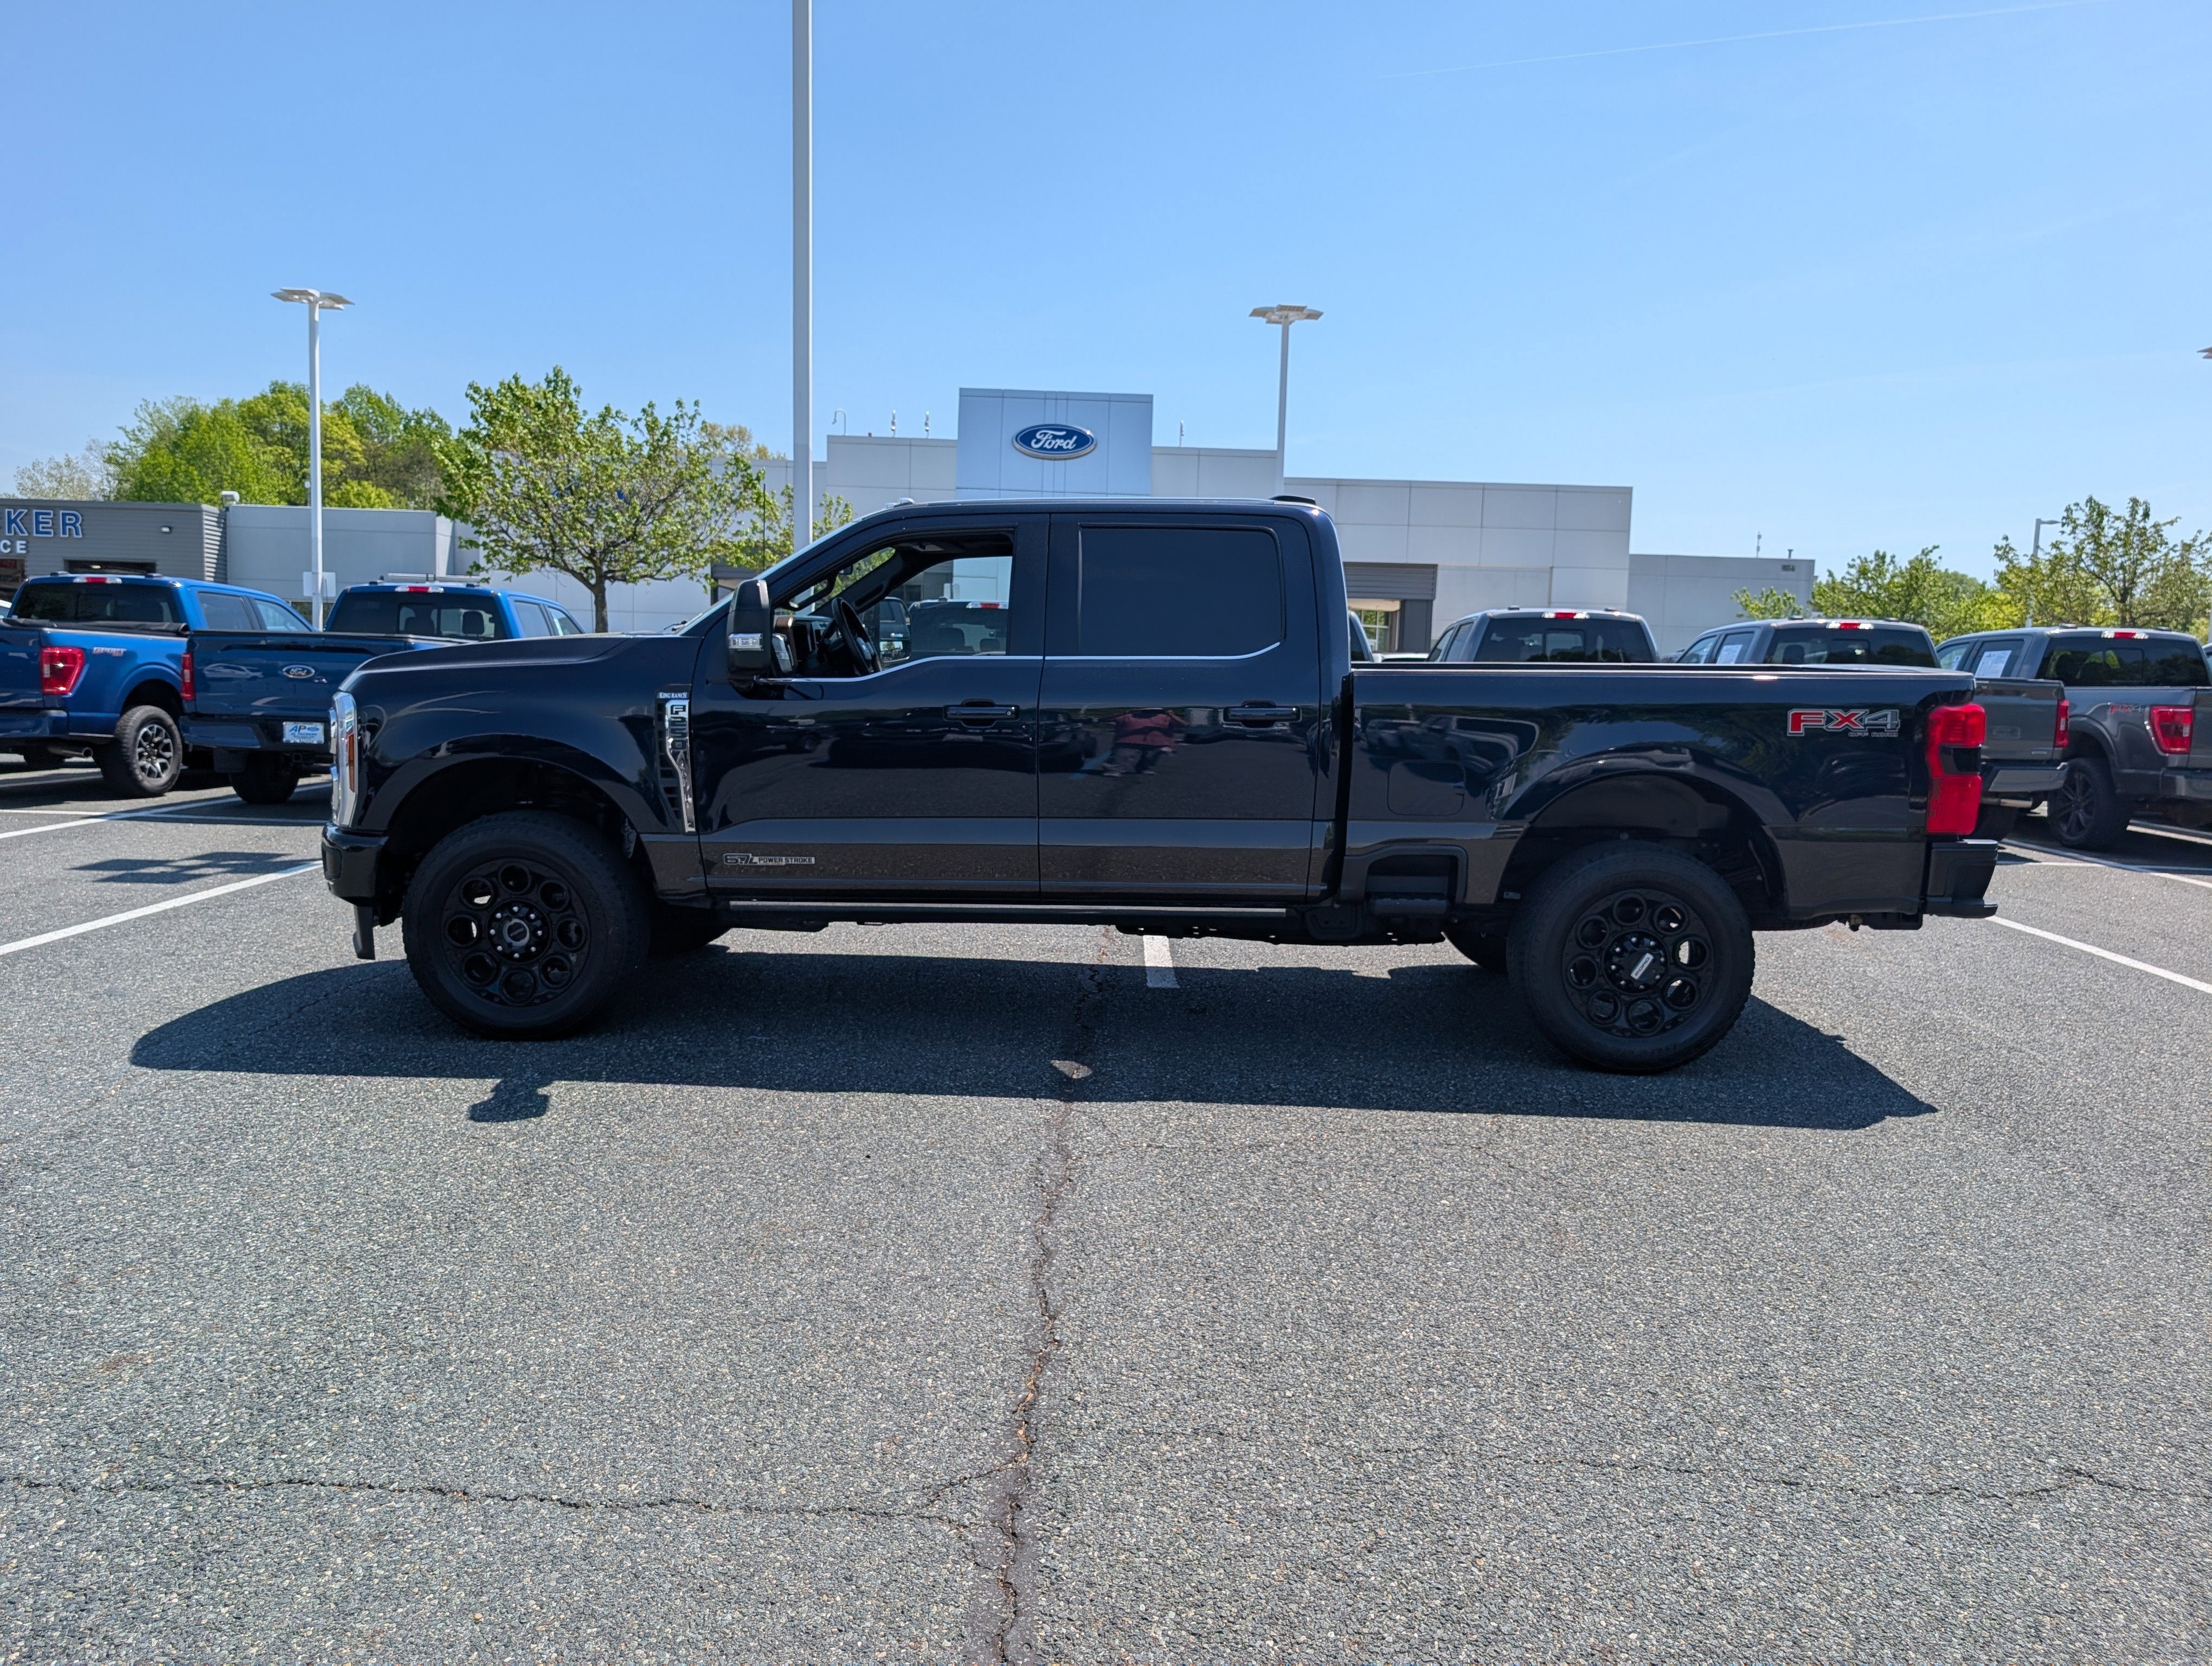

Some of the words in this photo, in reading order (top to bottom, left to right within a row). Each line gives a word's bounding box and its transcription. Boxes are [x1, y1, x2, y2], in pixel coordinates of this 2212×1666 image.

[1031, 430, 1078, 449] Ford
[5, 508, 82, 539] KER
[0, 539, 27, 554] CE
[1787, 708, 1900, 736] FX4
